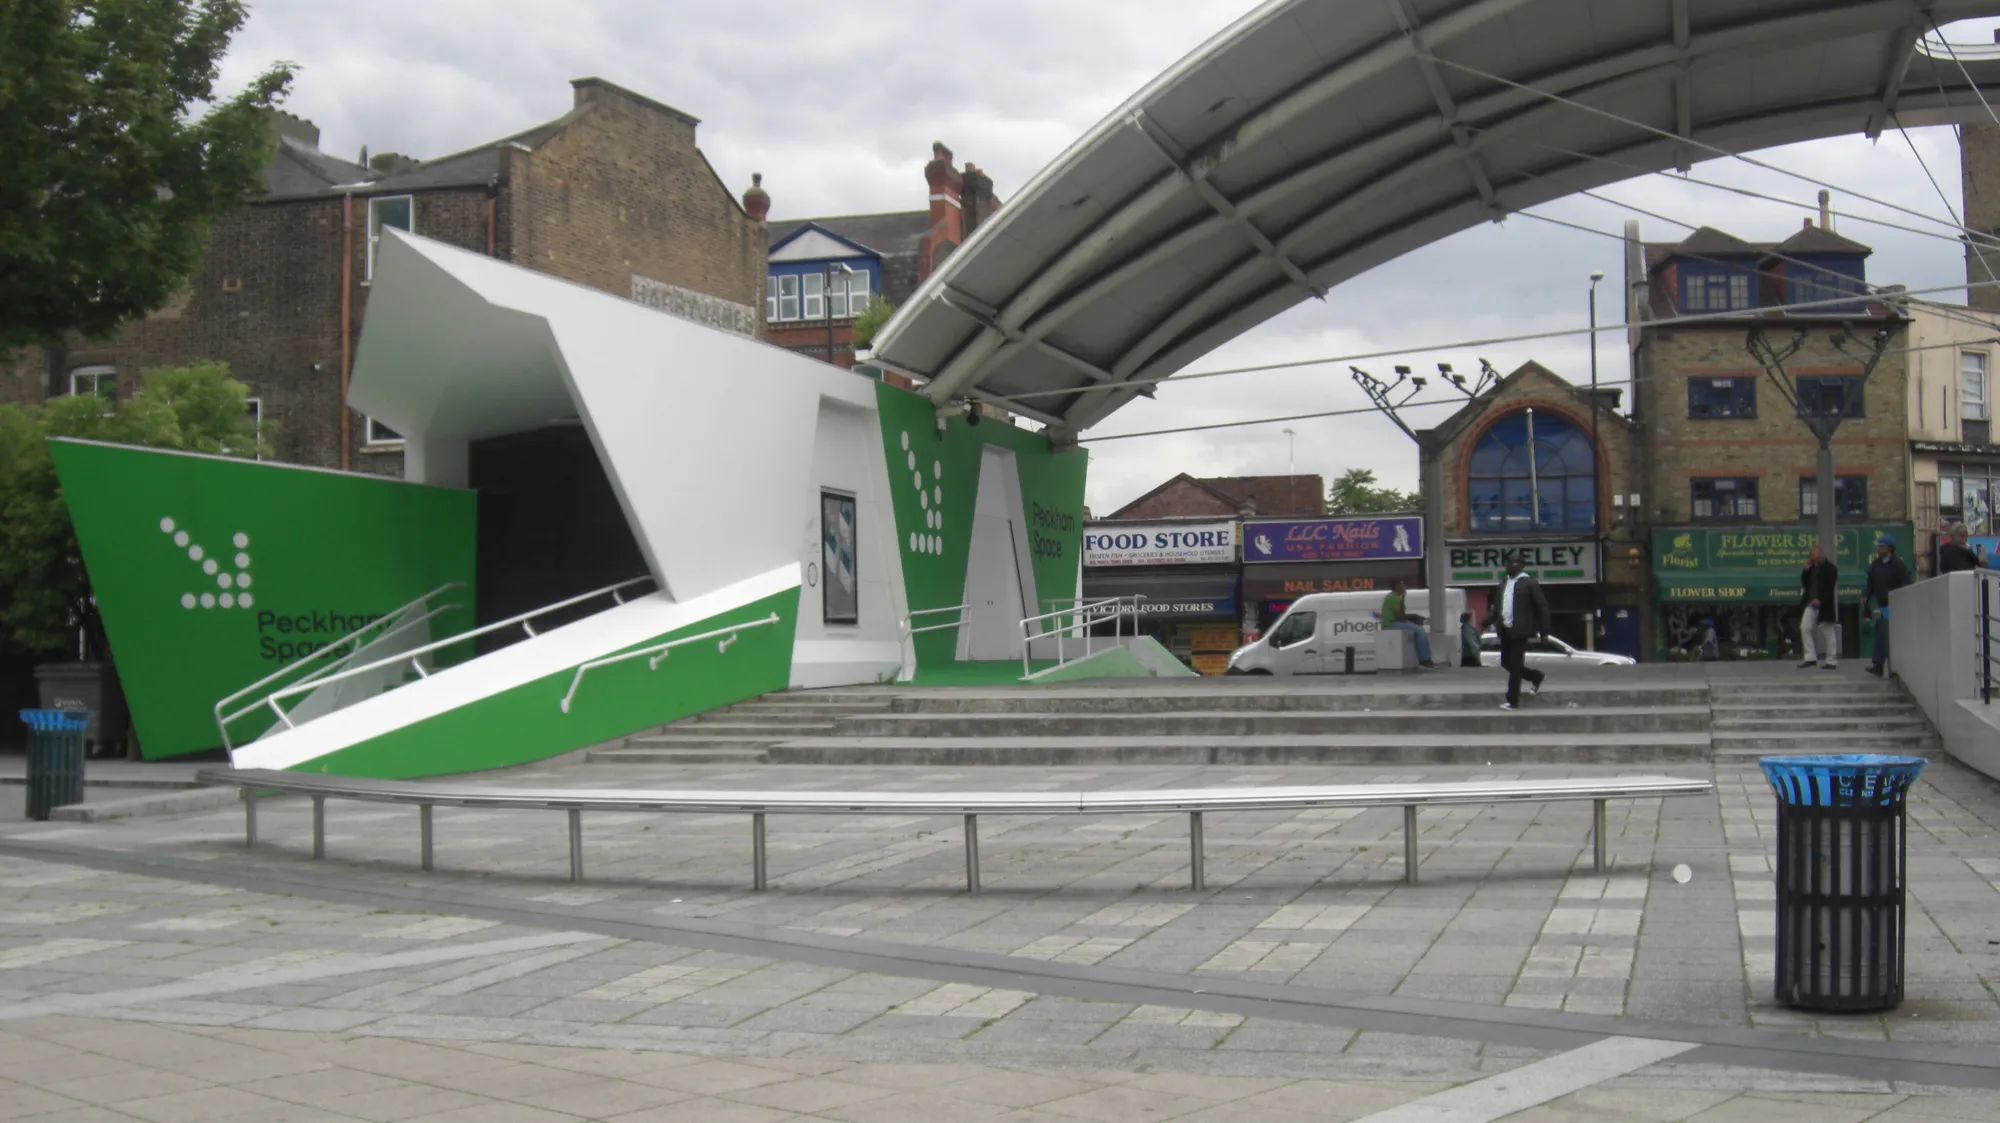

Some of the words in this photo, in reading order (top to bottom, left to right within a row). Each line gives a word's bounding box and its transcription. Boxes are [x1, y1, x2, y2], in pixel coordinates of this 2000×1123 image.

[1032, 501, 1075, 533] Peckham
[1085, 534, 1148, 550] FOOD
[1154, 531, 1230, 549] STORE
[1284, 525, 1328, 541] LLC
[1332, 520, 1380, 543] Nails
[1721, 534, 1794, 549] FLOWER
[1797, 533, 1845, 548] SHP
[1034, 529, 1062, 562] Space
[1451, 546, 1585, 568] BERKELEY
[1284, 579, 1317, 593] NAIL
[1322, 577, 1375, 592] SALON
[1671, 587, 1716, 597] FLOWER
[1718, 587, 1746, 597] SHOP
[1139, 603, 1170, 612] FOOD
[1172, 602, 1214, 612] STORES
[257, 610, 392, 633] Peckham
[259, 637, 350, 664] Space
